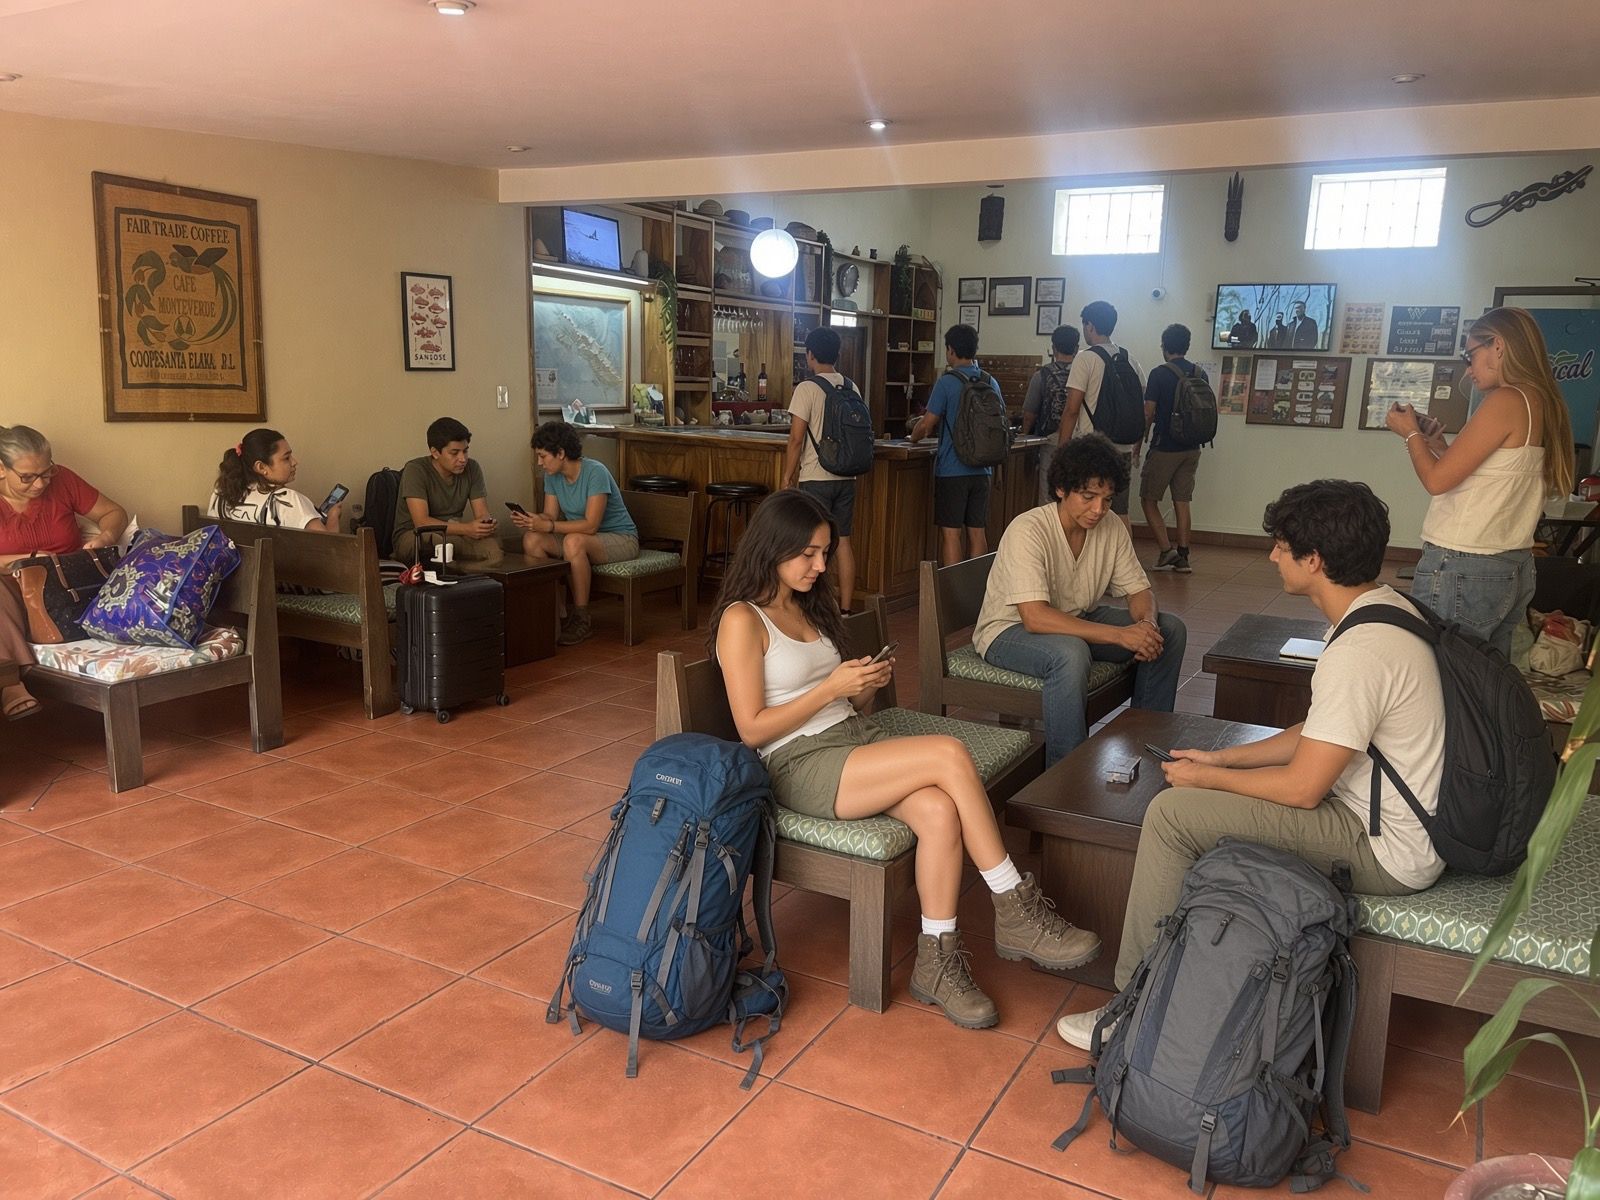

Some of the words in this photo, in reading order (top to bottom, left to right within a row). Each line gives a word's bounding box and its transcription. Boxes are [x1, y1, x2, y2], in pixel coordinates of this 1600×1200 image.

[126, 217, 151, 234] FAIR
[152, 220, 189, 239] TRADE
[190, 225, 230, 244] COFFEE
[158, 296, 216, 317] MONTEVERDE
